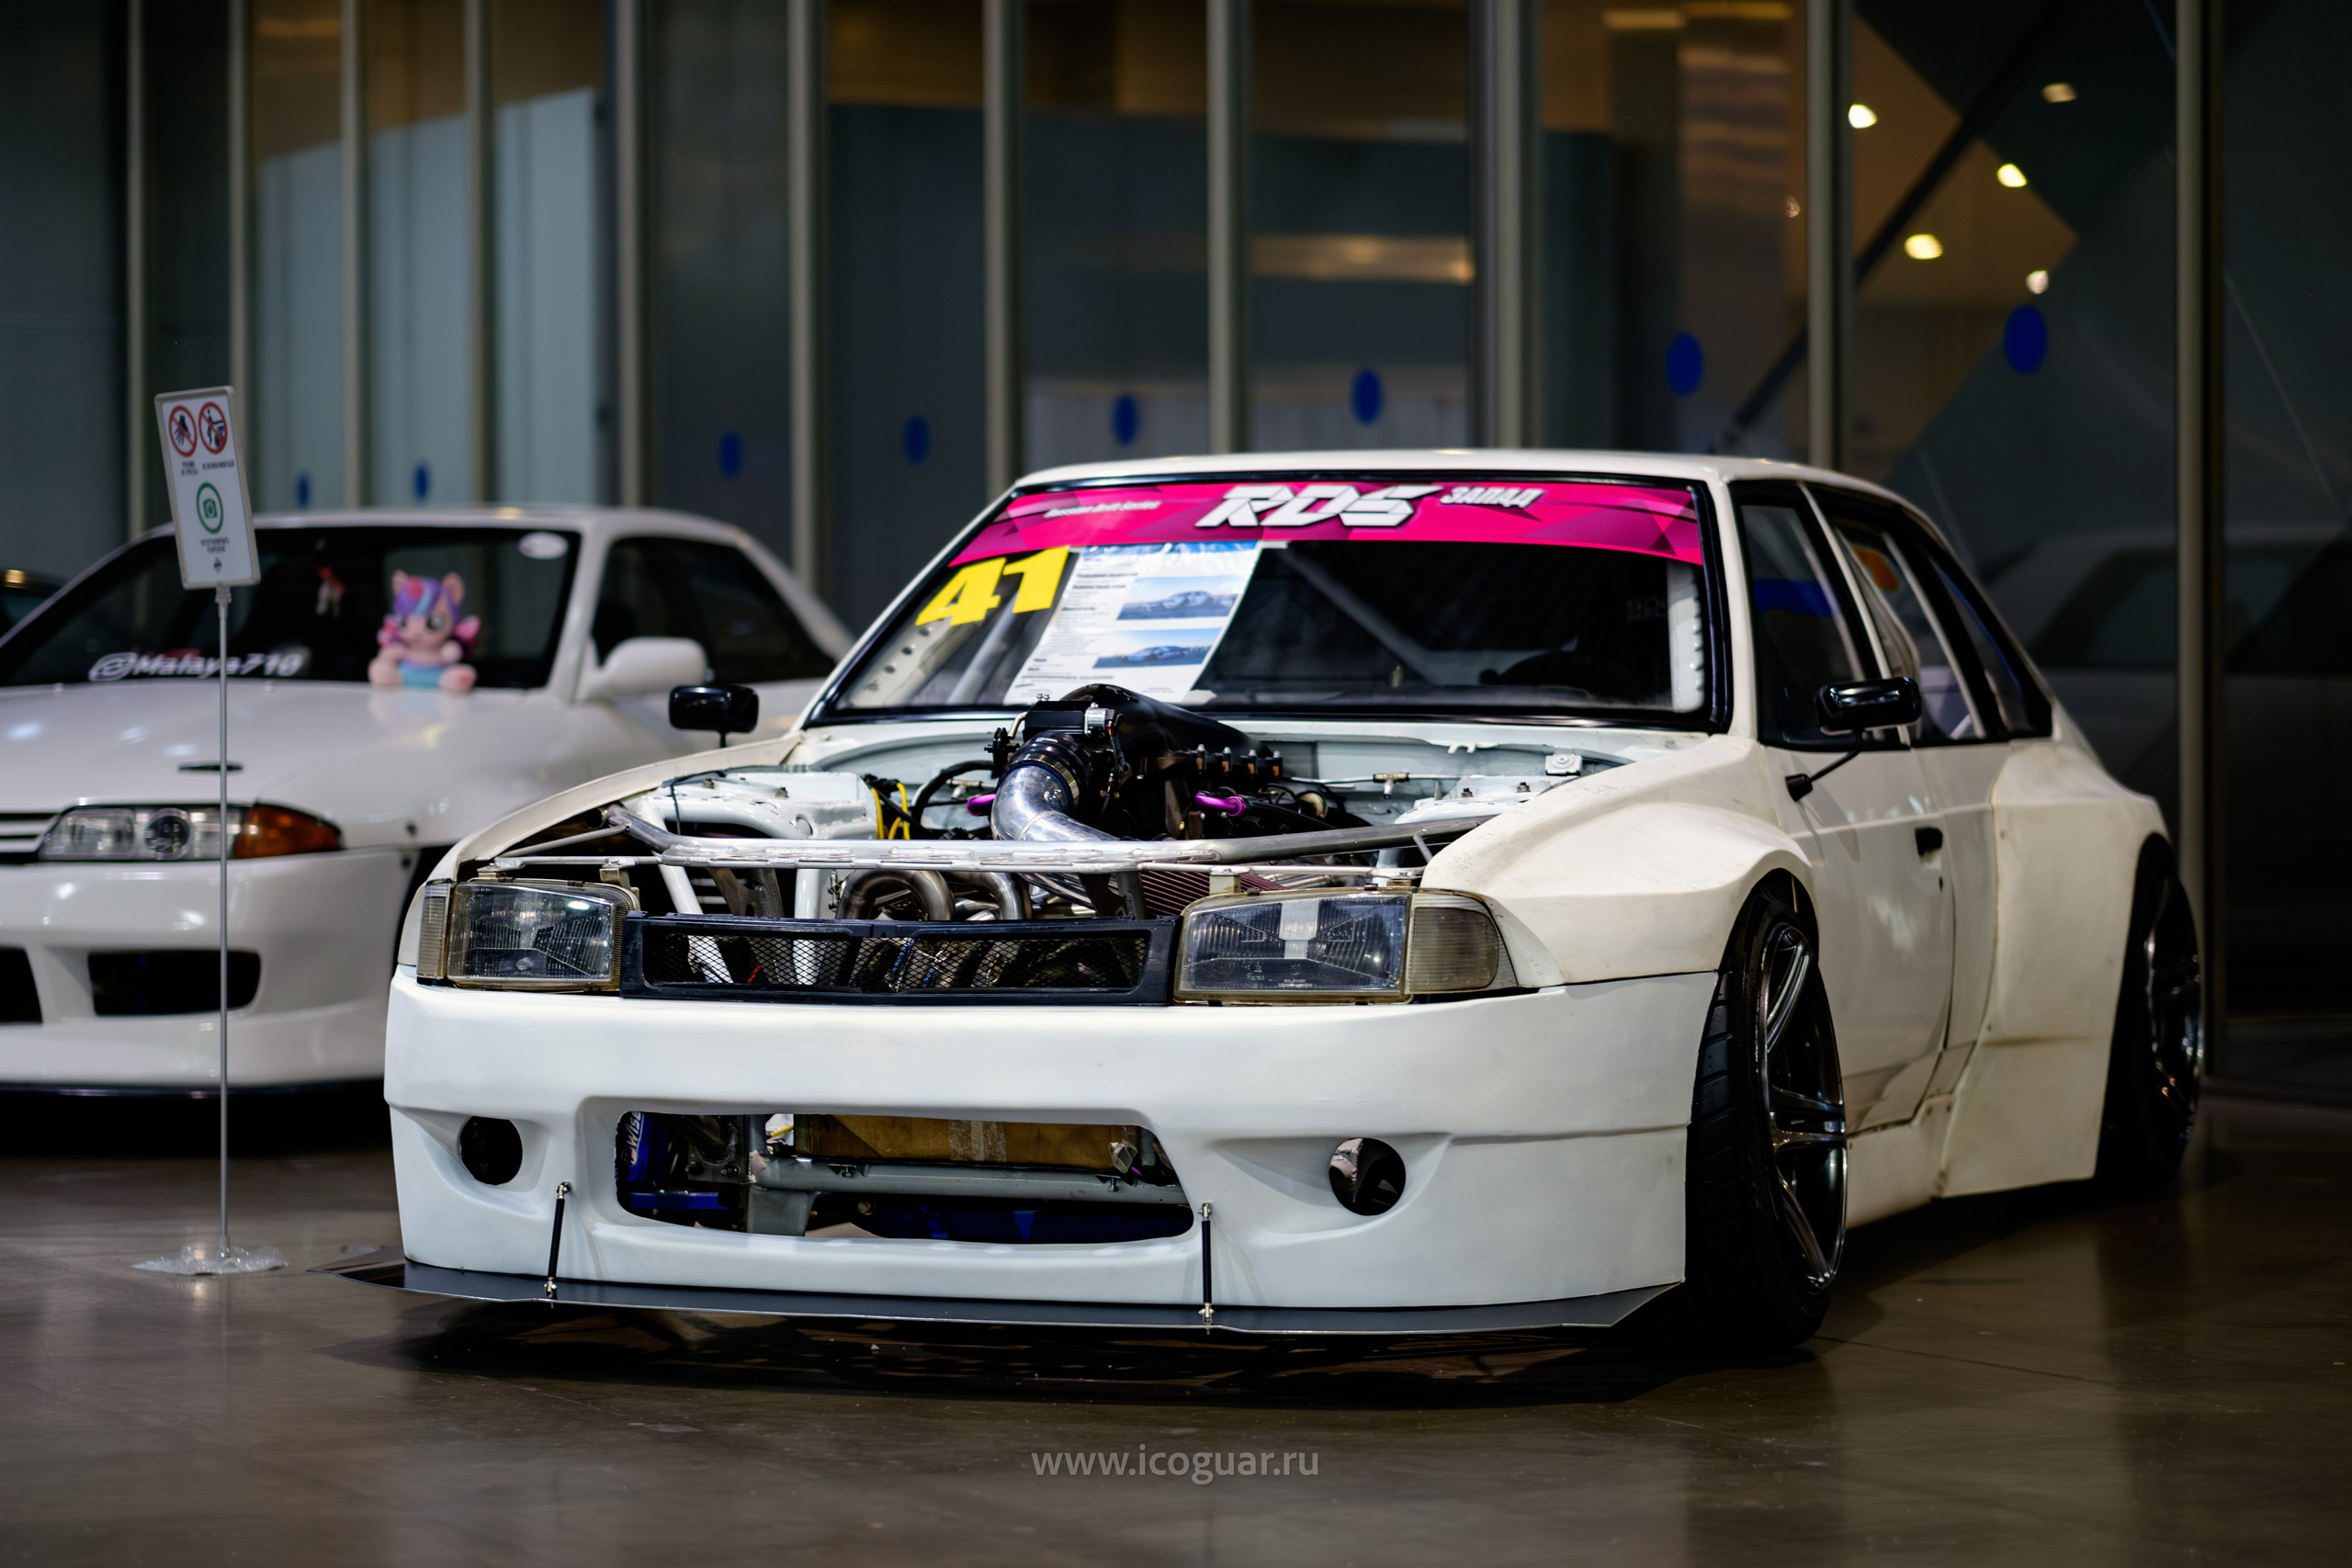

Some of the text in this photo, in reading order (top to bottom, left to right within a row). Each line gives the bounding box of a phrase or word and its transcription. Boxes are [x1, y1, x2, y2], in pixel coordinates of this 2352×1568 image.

[1194, 485, 1445, 527] RDS
[1440, 486, 1545, 509] ЗАПАД
[915, 546, 1069, 626] 41
